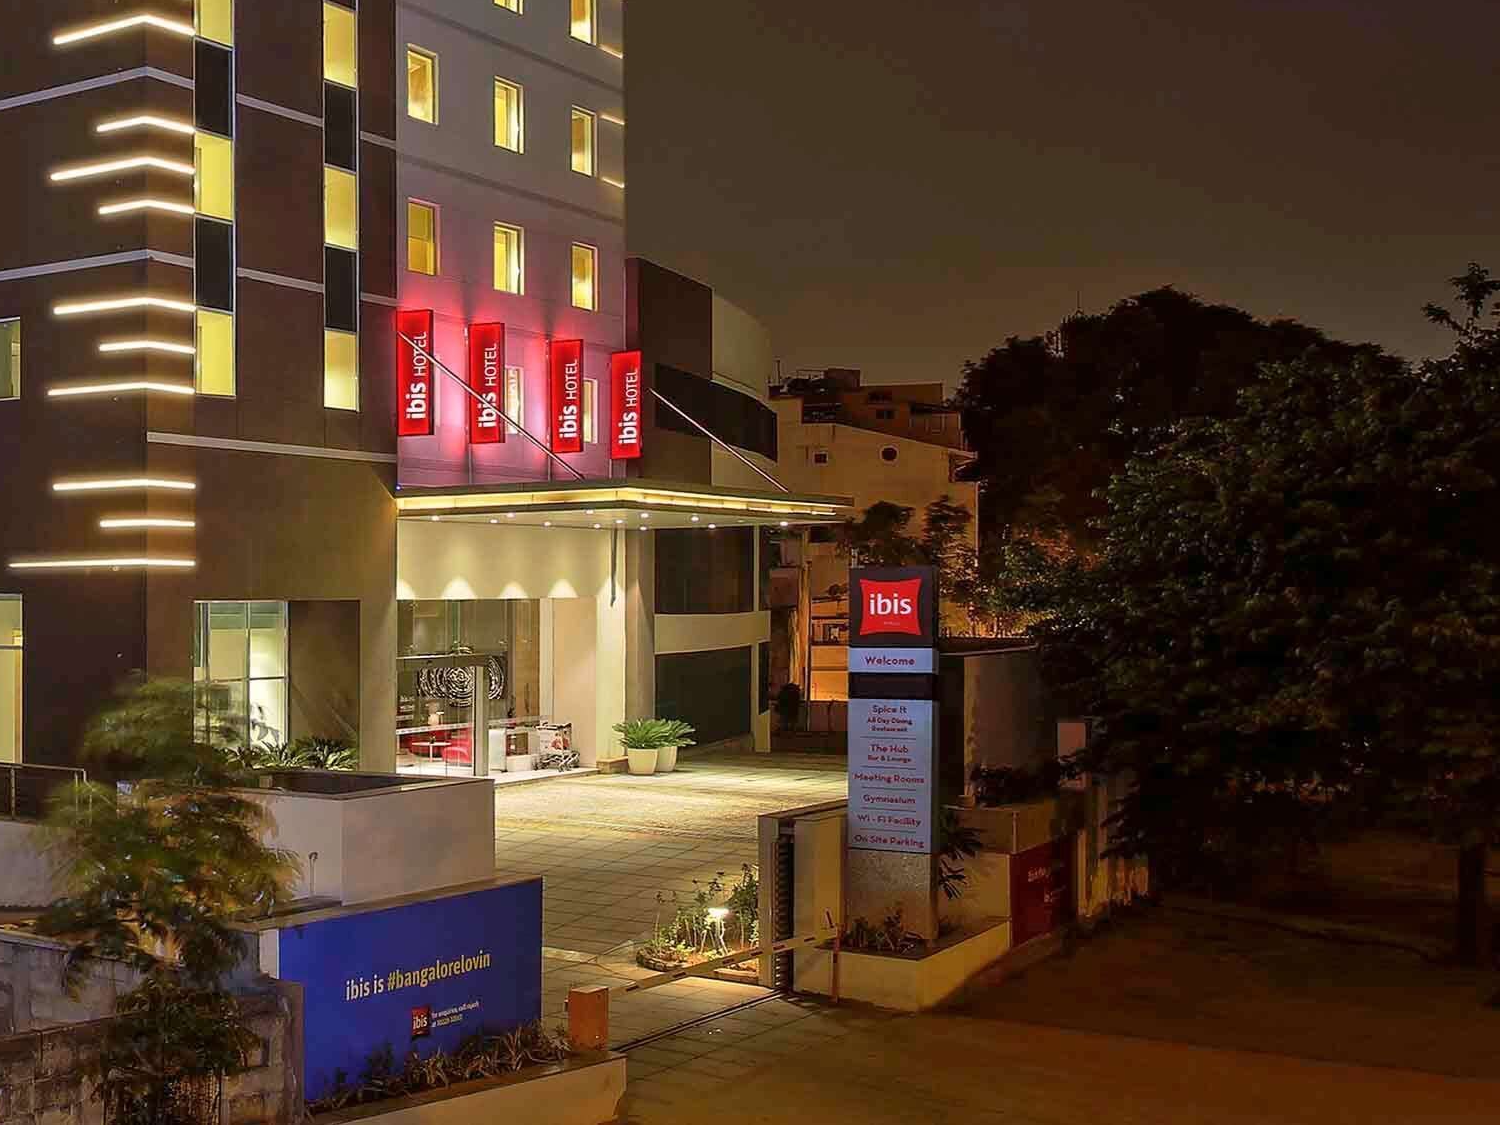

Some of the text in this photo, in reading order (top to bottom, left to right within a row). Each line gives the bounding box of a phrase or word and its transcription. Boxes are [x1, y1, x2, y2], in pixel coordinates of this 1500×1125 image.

[406, 332, 427, 419] ibis HOTEL
[478, 343, 497, 427] ibis HOTEL
[559, 359, 577, 438] ibis HOTEL
[618, 368, 638, 444] ibis HOTEL
[869, 593, 912, 615] ibis
[865, 656, 915, 665] Welcome
[871, 744, 909, 753] The Hub
[854, 773, 925, 784] Meeting Rooms
[863, 794, 916, 804] Gymnasium
[869, 836, 888, 844] Site
[890, 837, 925, 849] Parking
[346, 949, 491, 1001] ibis is #bangalorelovin
[413, 1015, 428, 1030] ibis
